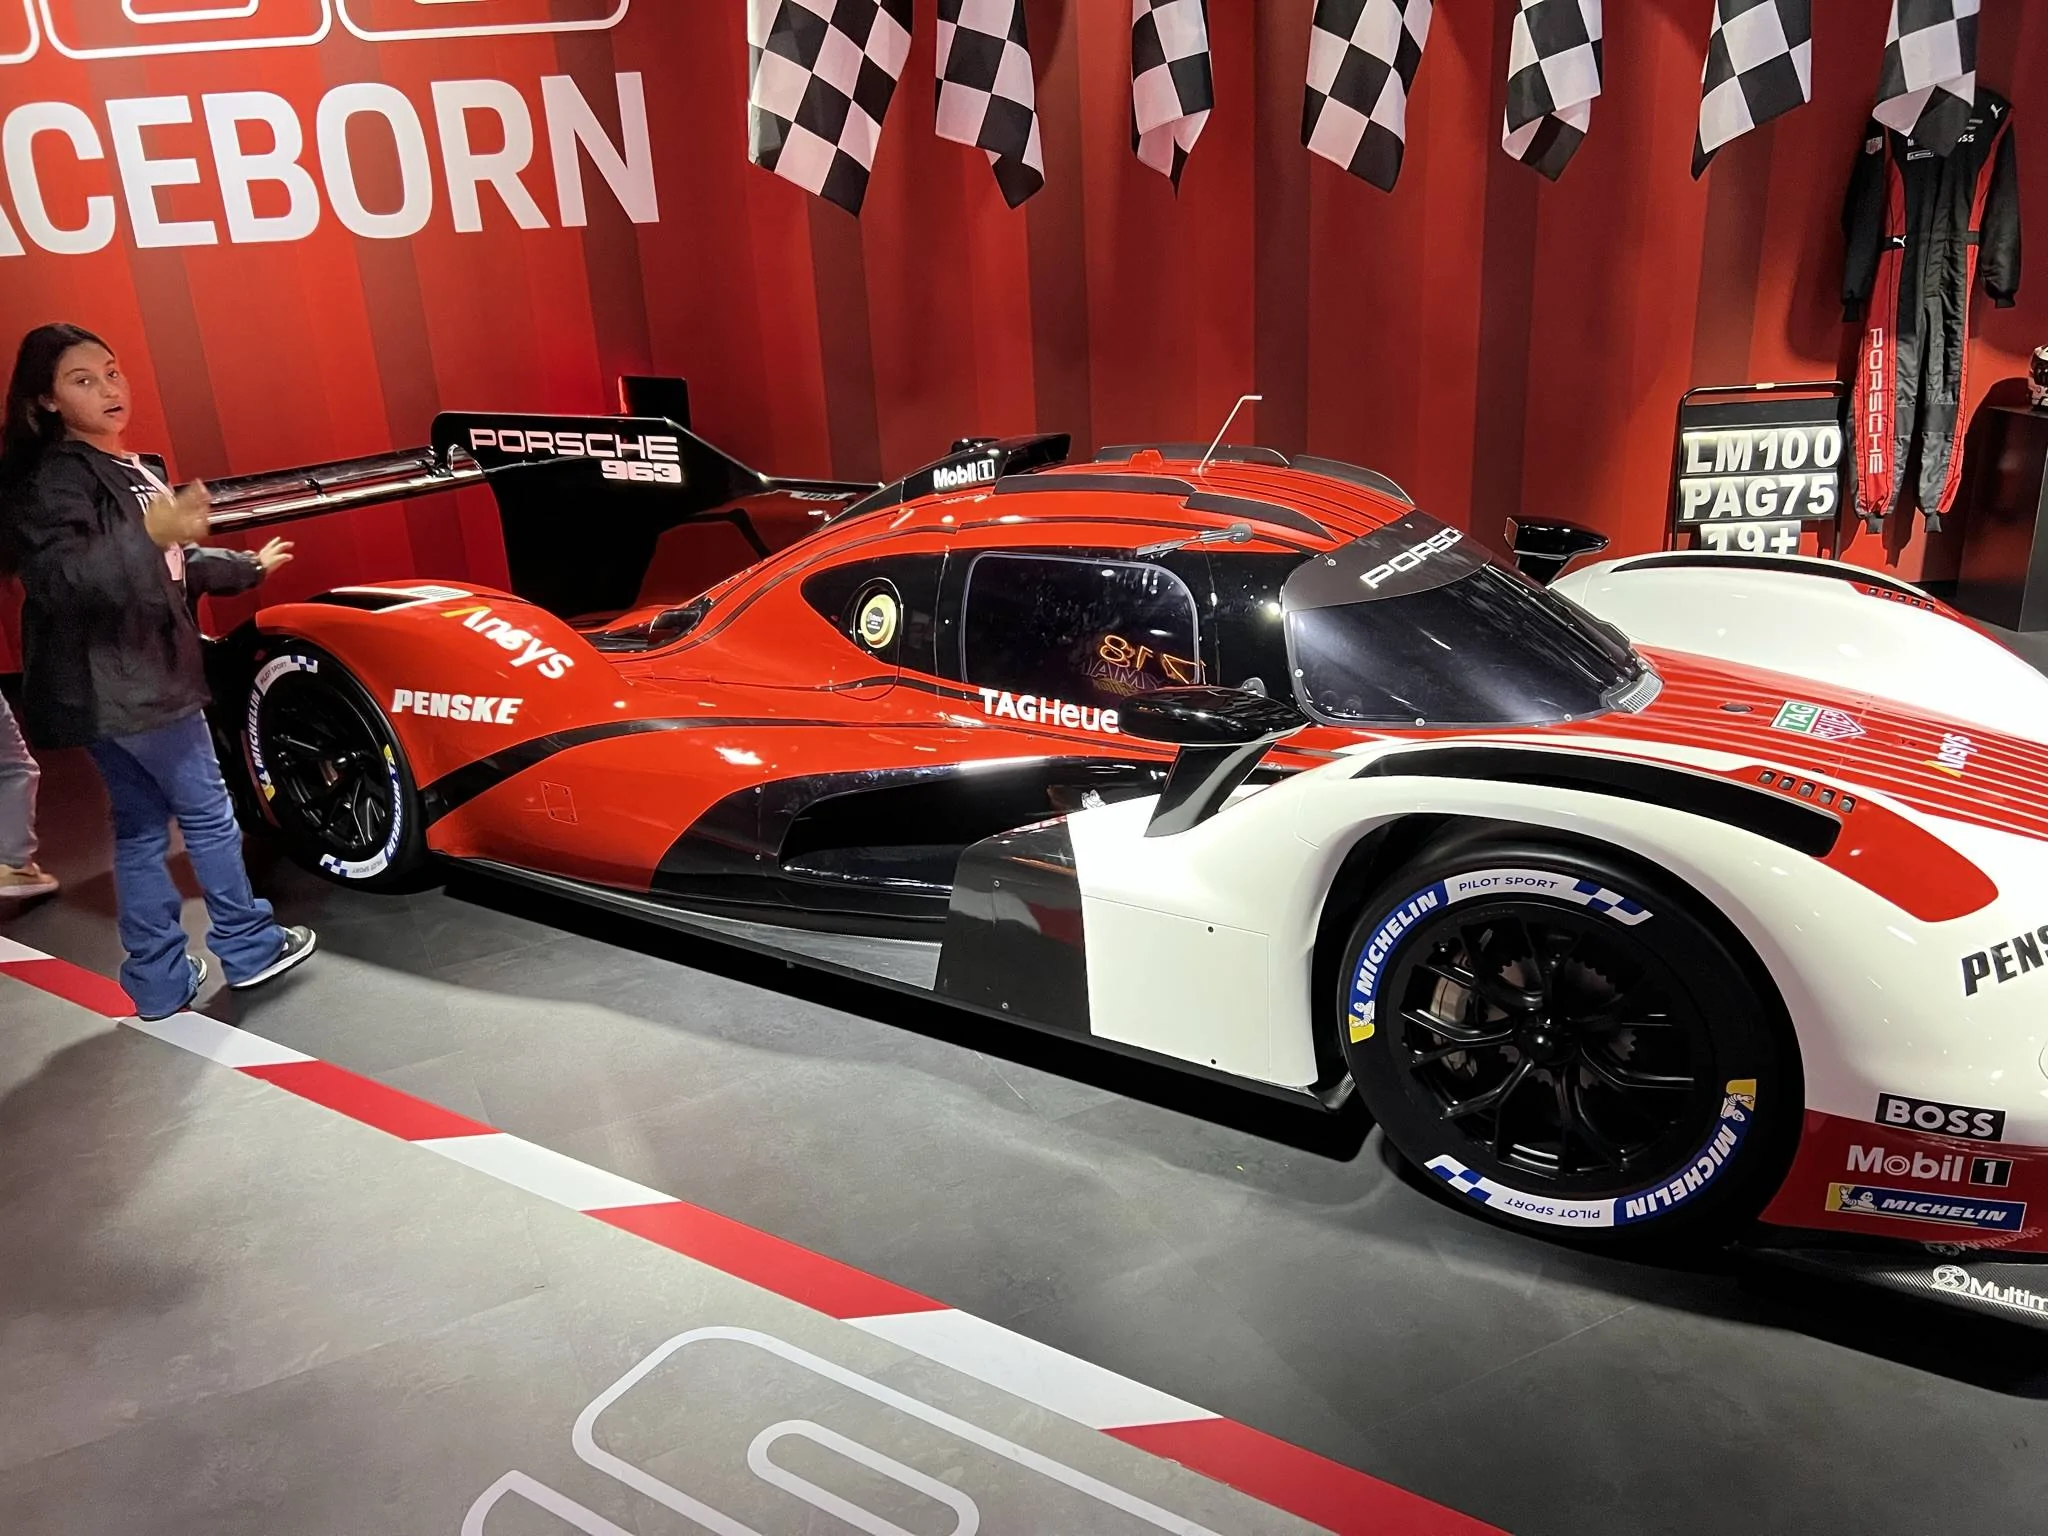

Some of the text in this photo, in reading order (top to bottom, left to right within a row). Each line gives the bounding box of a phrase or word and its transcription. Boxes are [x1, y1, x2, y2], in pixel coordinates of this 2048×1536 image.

[0, 71, 660, 256] CEBORN
[1868, 327, 1883, 474] PORSCHE
[469, 428, 680, 461] PORSCHE
[1685, 428, 1842, 474] LM100
[600, 460, 682, 484] 963
[933, 464, 976, 489] Mobil
[1682, 475, 1835, 519] PAG75
[1706, 525, 1797, 555] 19+
[439, 605, 575, 680] Ansys
[391, 688, 524, 725] PENSKE
[1780, 704, 1816, 728] TAG
[247, 688, 264, 768] MICHELIN
[1923, 732, 1978, 779] Ansys
[386, 778, 402, 857] MICHELIN
[1459, 876, 1559, 892] PILOT SPORT
[1355, 890, 1438, 996] MICHELIN
[1885, 1098, 1994, 1138] BOSS
[1625, 1124, 1738, 1219] MICHELIN
[1846, 1144, 1965, 1183] Mobil
[1504, 1197, 1600, 1219] PILOT SPORT
[1880, 1198, 2008, 1222] MICHELIN
